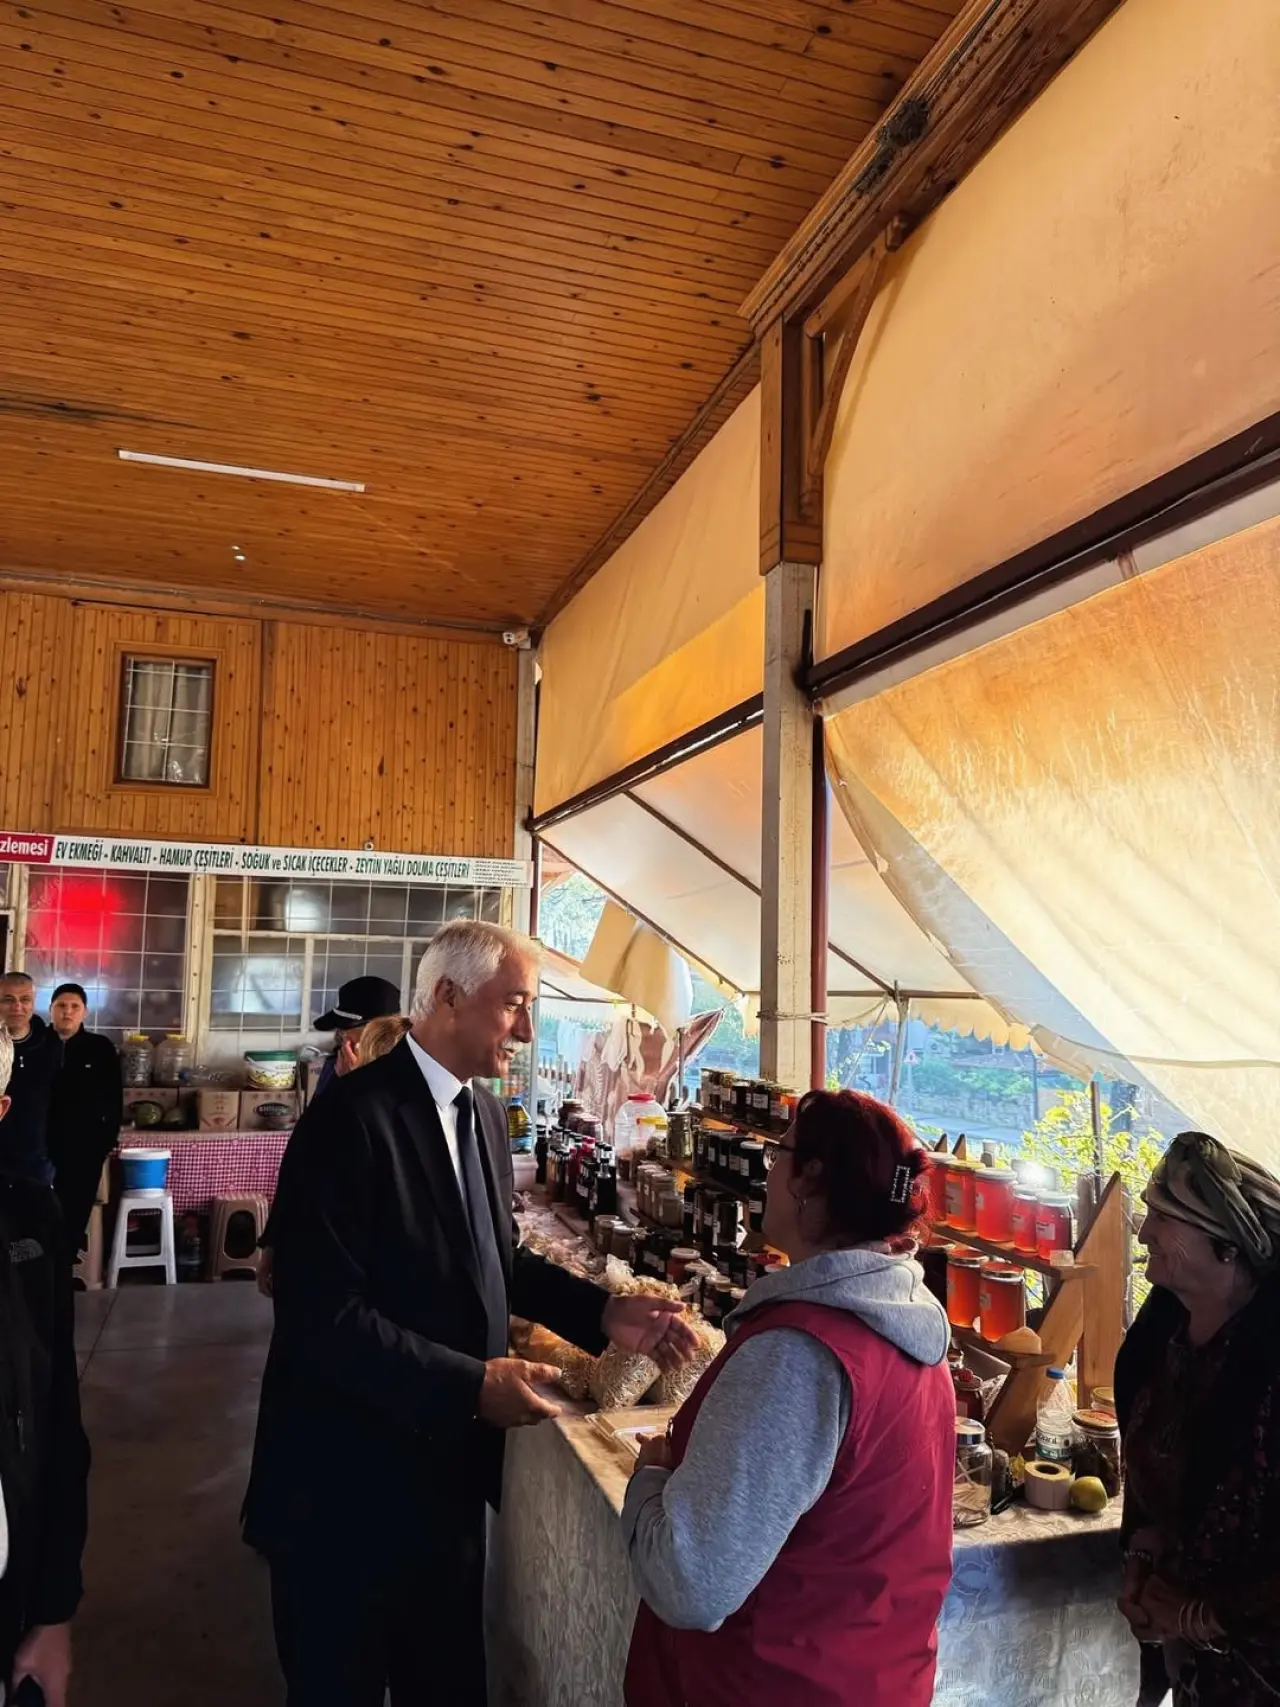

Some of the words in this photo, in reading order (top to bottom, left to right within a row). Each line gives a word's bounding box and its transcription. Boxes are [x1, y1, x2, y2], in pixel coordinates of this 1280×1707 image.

[56, 842, 68, 859] EV
[110, 844, 152, 864] KAHVALTI
[160, 847, 193, 867] HAMUR
[241, 848, 271, 870] SOĞUK
[272, 858, 282, 870] ve
[283, 854, 308, 872] SICAK
[407, 860, 434, 877] DOLMA
